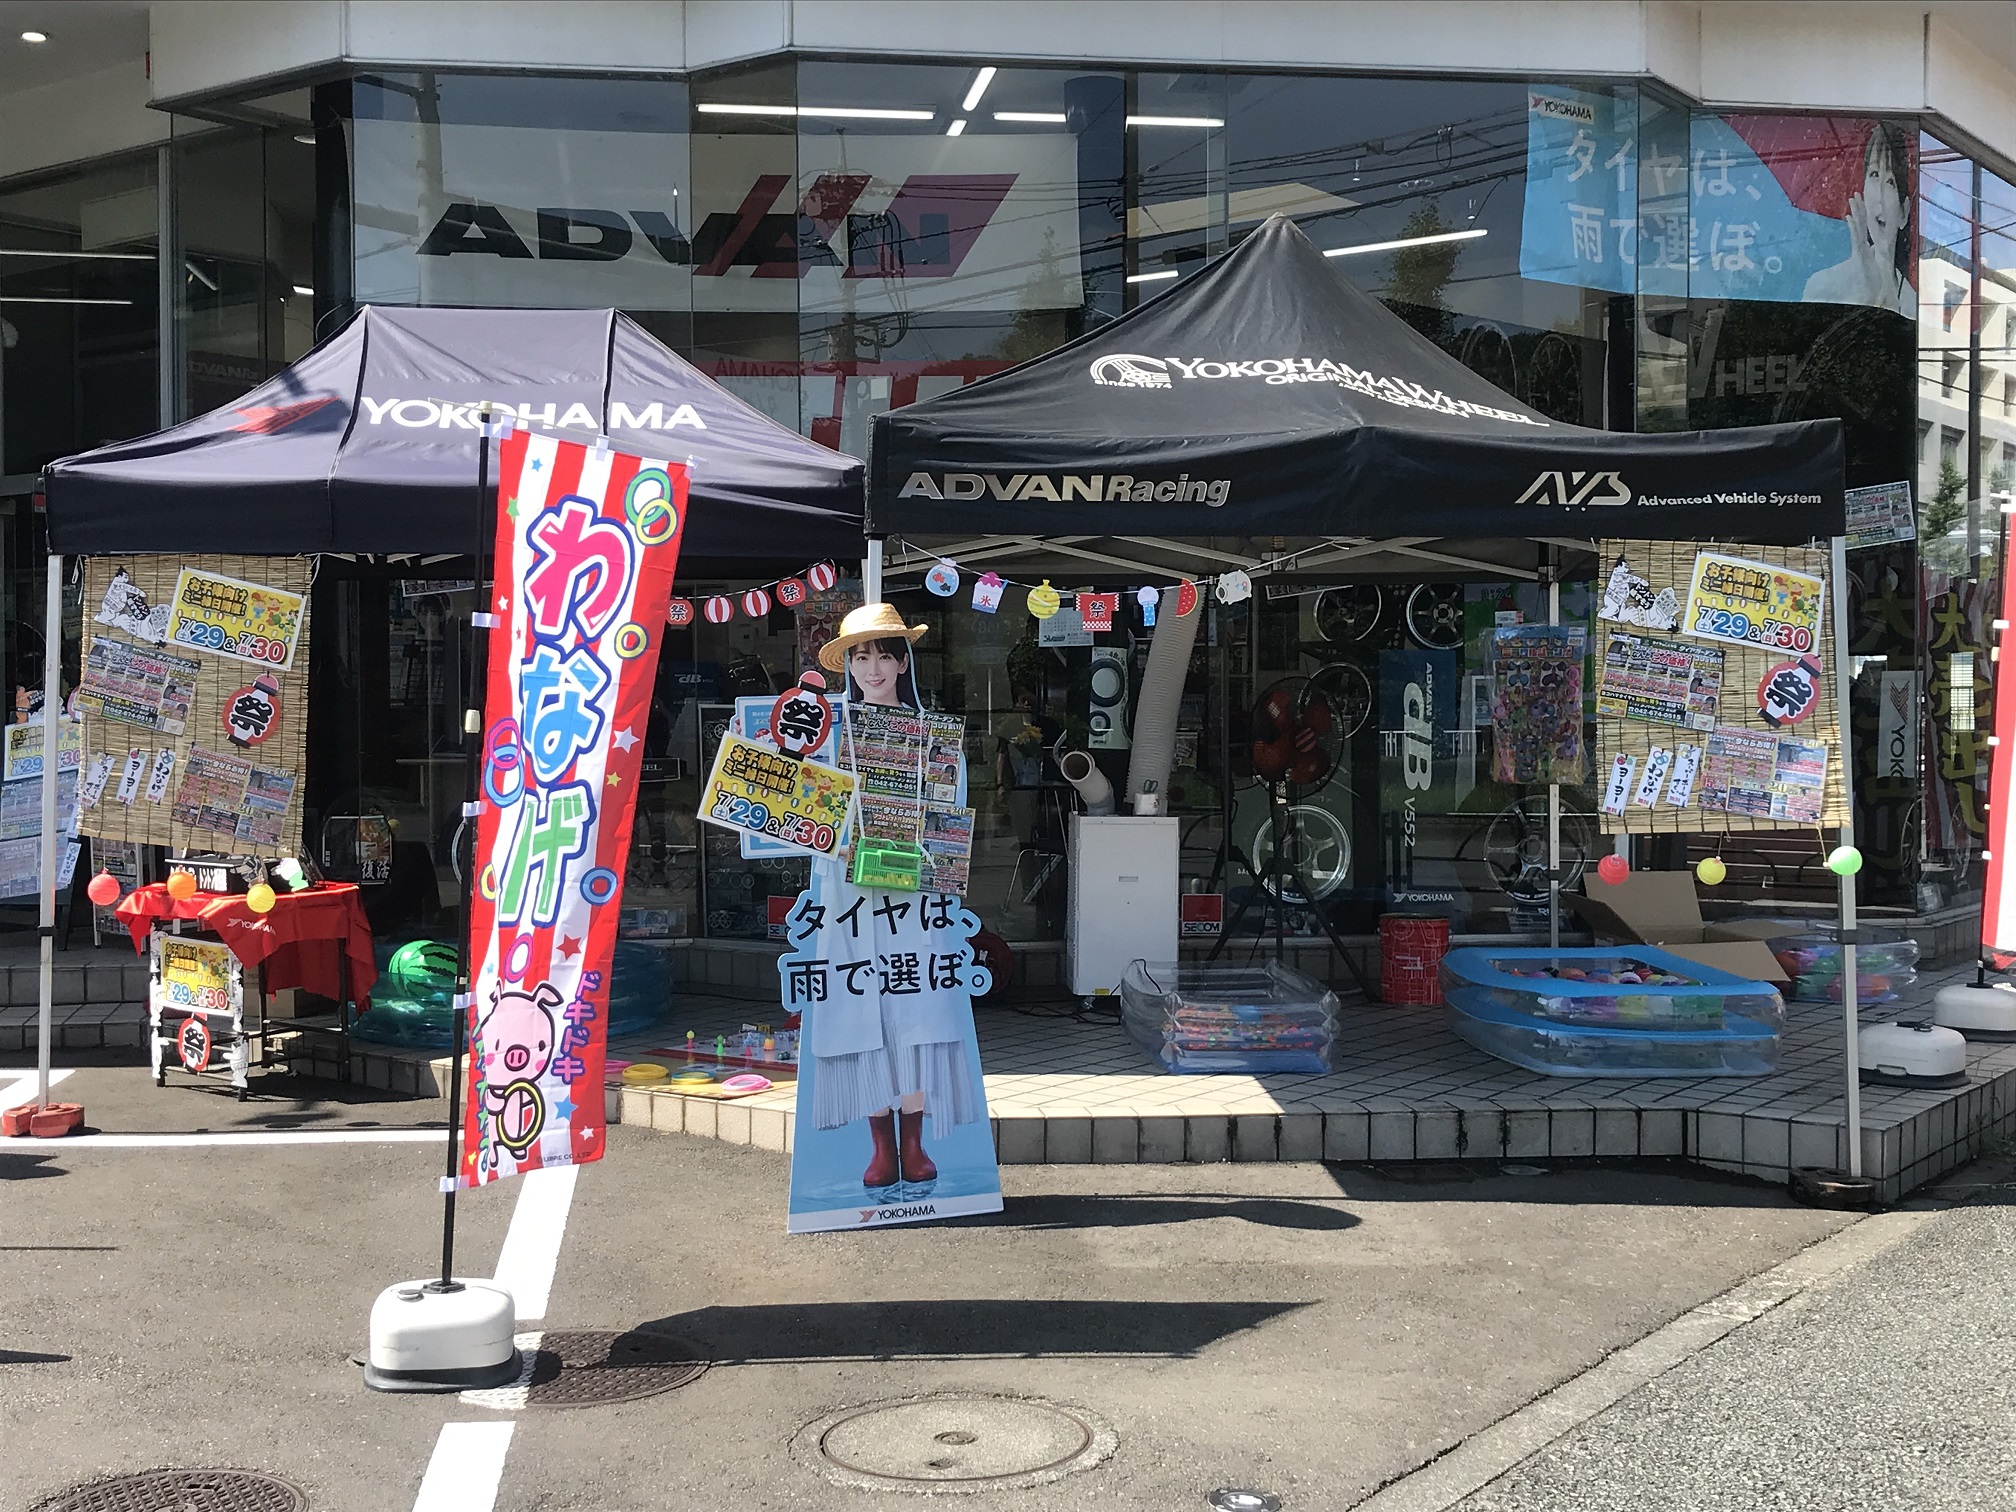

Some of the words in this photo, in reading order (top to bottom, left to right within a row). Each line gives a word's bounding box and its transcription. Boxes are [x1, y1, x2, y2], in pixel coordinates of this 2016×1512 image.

[1544, 99, 1592, 121] YOKOHAMA
[1566, 128, 1762, 201] タイヤは、
[1567, 202, 1783, 274] 雨で選ぼ。
[1164, 357, 1397, 394] YOKOHAMA
[1392, 376, 1550, 428] WHEEL
[1265, 372, 1381, 396] ORIGINAL
[1384, 390, 1469, 419] DESIGN
[361, 397, 708, 430] YOKOHAMA
[897, 472, 1103, 502] ADVAN
[1105, 473, 1232, 508] Racing
[1637, 494, 1712, 507] Advanced
[1714, 492, 1767, 505] Vehicle
[1769, 491, 1822, 507] System
[782, 582, 800, 601] 祭
[980, 595, 991, 606] 氷
[669, 604, 687, 622] 祭
[1089, 601, 1107, 619] 祭
[224, 638, 236, 650] &
[1749, 628, 1761, 640] &
[1424, 662, 1433, 716] ADVAN
[233, 695, 273, 738] 祭
[500, 497, 634, 926] わなげ
[779, 698, 824, 745] 祭
[730, 744, 798, 778] お子様向け
[766, 817, 779, 834] &
[1404, 797, 1417, 848] V552
[1408, 893, 1453, 902] YOKOHAMA
[795, 894, 973, 941] タイヤは、
[1184, 922, 1220, 932] SECOM
[787, 949, 985, 1004] 雨で選ぼ。
[552, 971, 602, 1084] ドキドキ
[878, 1205, 936, 1220] YOKOHAMA
